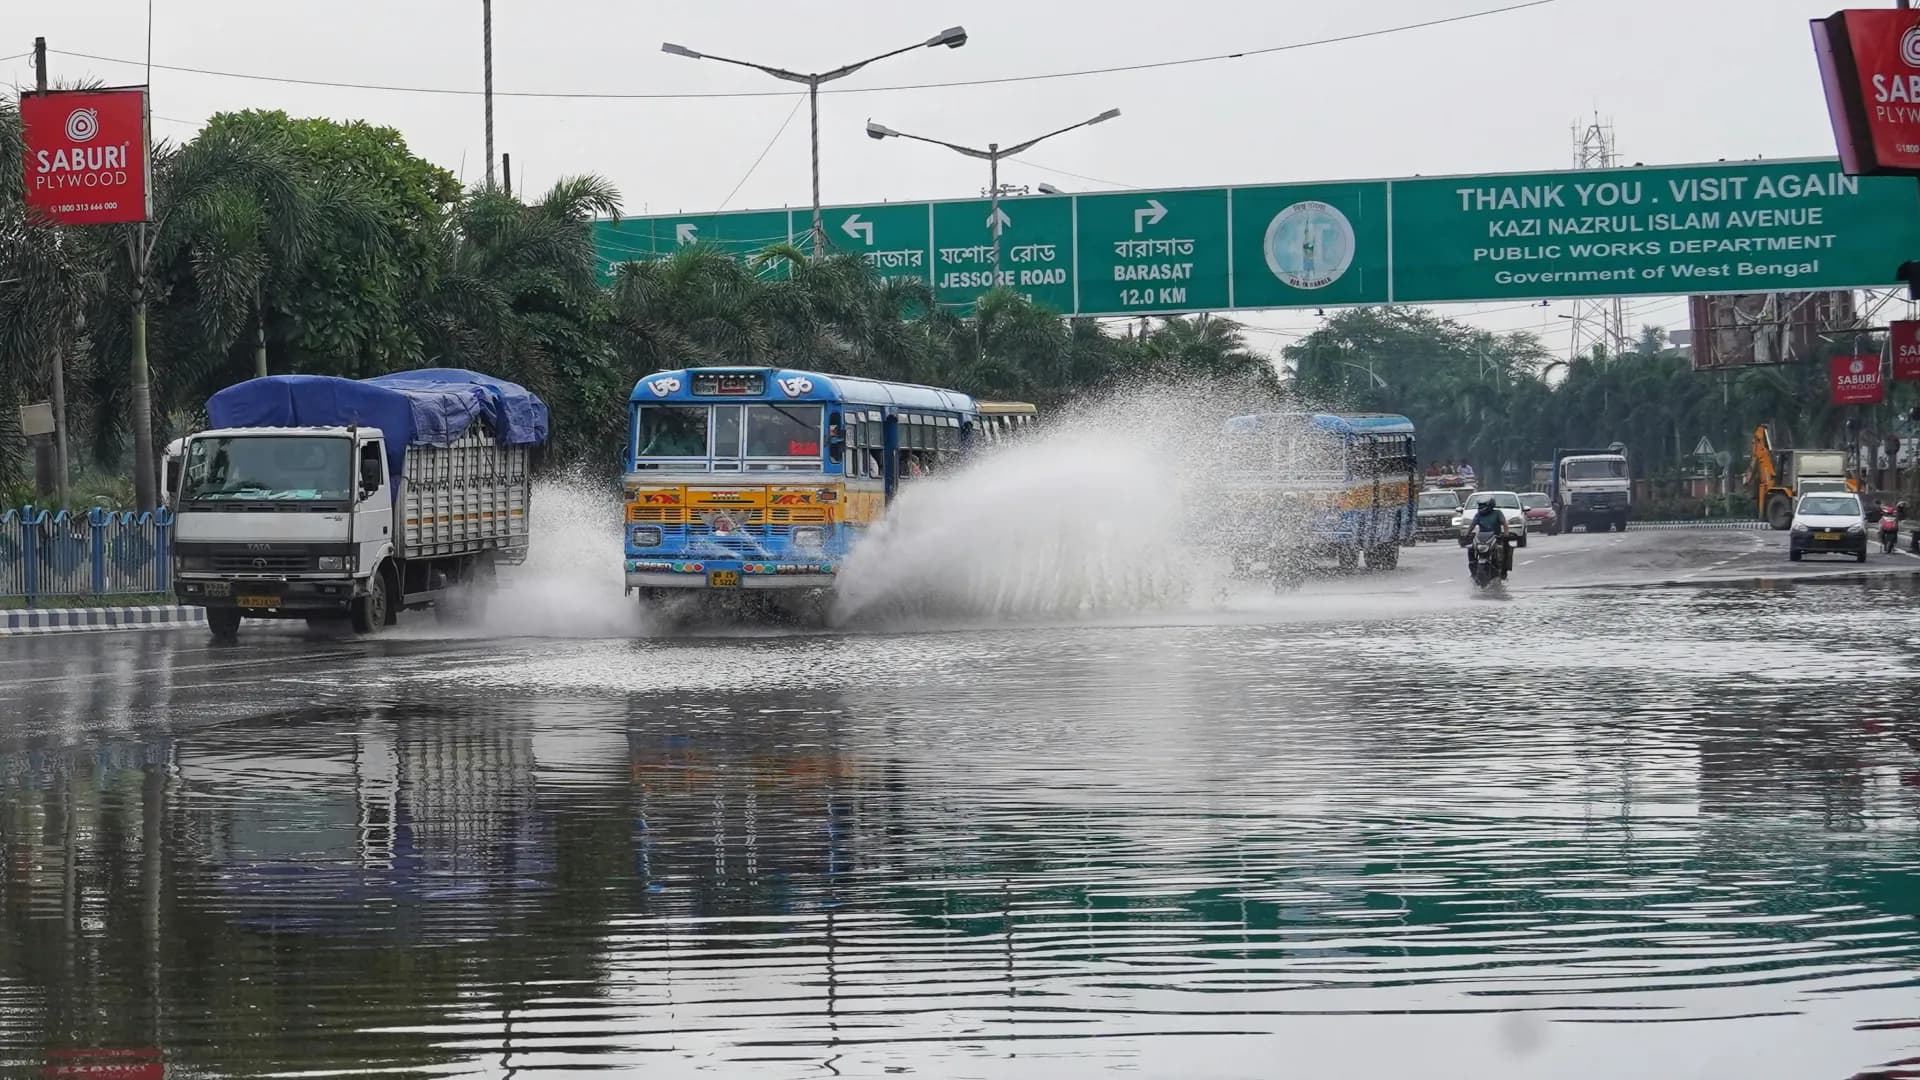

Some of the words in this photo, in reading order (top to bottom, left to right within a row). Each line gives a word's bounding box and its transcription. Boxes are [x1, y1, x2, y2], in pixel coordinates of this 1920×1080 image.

[1872, 73, 1920, 103] SAB
[37, 145, 126, 173] SABURI
[36, 171, 127, 190] PLYWOOD
[1456, 184, 1565, 211] THANK
[1574, 181, 1642, 206] YOU
[1669, 177, 1748, 202] VISIT
[1754, 172, 1859, 199] AGAIN
[58, 204, 75, 212] 1800
[75, 203, 89, 212] 313
[1488, 219, 1541, 237] KAZI
[1548, 215, 1643, 235] NAZRUL
[1648, 212, 1720, 231] ISLAM
[1726, 208, 1823, 228] AVENUE
[1010, 244, 1056, 263] রোড
[1113, 238, 1195, 258] বারাসাত
[1473, 245, 1561, 261] PUBLIC
[1568, 241, 1661, 257] WORKS
[1669, 235, 1837, 254] DEPARTMENT
[1021, 268, 1066, 286] ROAD
[1114, 263, 1193, 281] BARASAT
[1494, 267, 1636, 284] Government
[1641, 266, 1665, 279] of
[1671, 264, 1731, 278] West
[1737, 260, 1819, 278] Bengal
[1120, 288, 1154, 305] 12.0
[1160, 288, 1186, 304] KM
[1900, 343, 1920, 357] SA
[1837, 374, 1876, 385] SABURI
[247, 543, 271, 551] TATA
